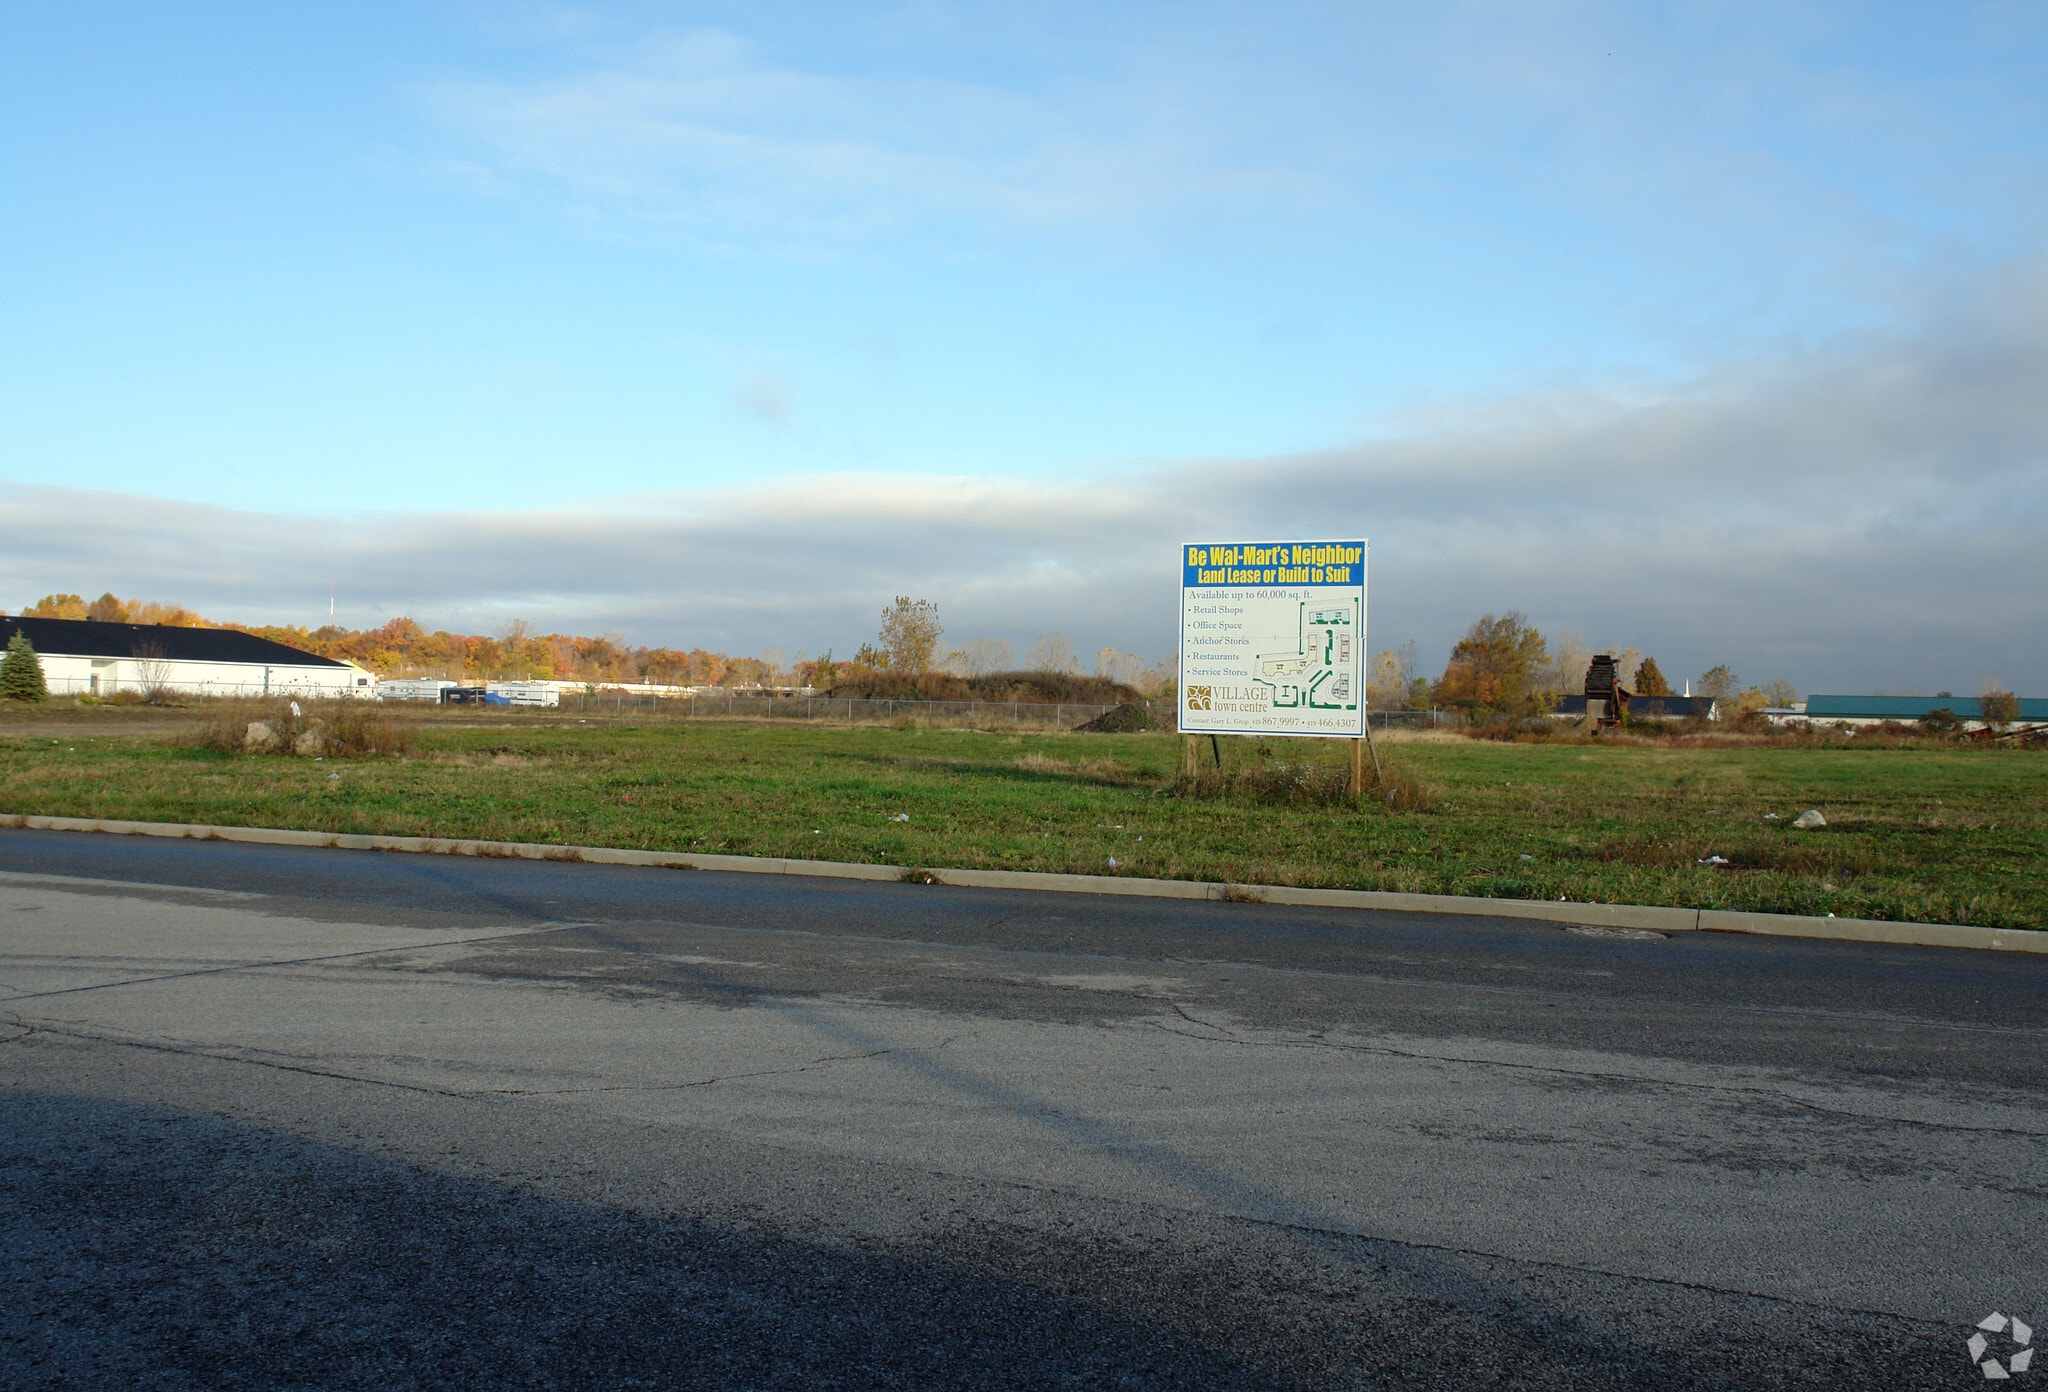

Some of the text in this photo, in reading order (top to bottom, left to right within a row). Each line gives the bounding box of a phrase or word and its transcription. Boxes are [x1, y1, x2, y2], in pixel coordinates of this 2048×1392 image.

[1188, 545, 1362, 566] Be Wal-Mart's Neighbor
[1198, 566, 1350, 583] Land Lease or Build to Suit
[1189, 590, 1313, 601] Available up to 60,000 sq. ft.
[1193, 606, 1244, 615] Retail Shops
[1192, 621, 1243, 631] Office Space
[1192, 636, 1250, 645] Anchor Stores
[1192, 652, 1240, 660] Restaurants
[1191, 667, 1248, 676] Service Stores
[1213, 687, 1268, 700] VILLAGE
[1214, 702, 1268, 712] town centre
